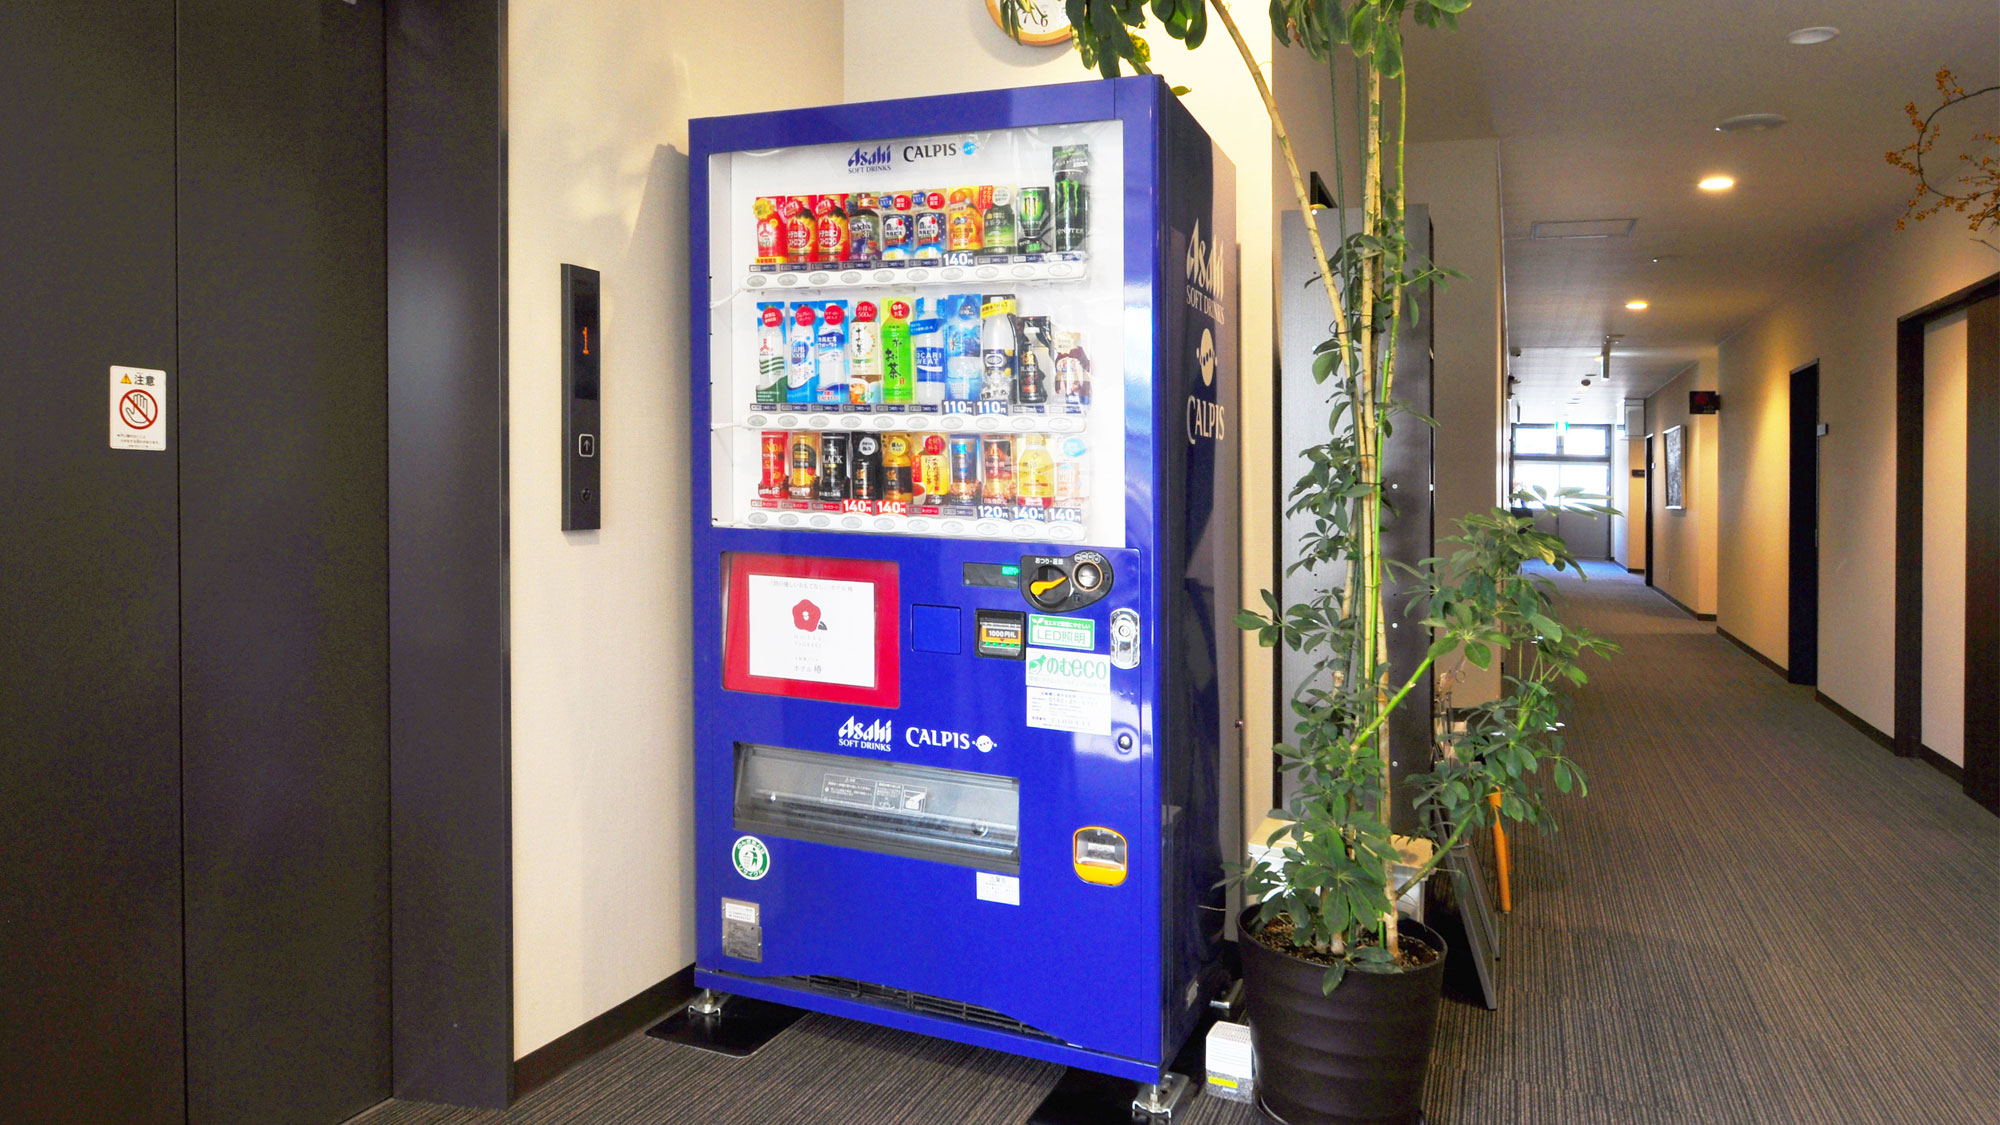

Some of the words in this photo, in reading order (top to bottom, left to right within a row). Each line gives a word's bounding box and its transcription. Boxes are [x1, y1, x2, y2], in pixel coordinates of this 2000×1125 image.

[848, 144, 891, 167] Asahi
[903, 143, 957, 162] CALPIS
[866, 165, 891, 173] DRINKS
[1186, 218, 1225, 301] Asahi
[583, 327, 589, 355] 1
[134, 374, 155, 386] 注意
[1186, 395, 1225, 445] CALPIS
[1037, 629, 1086, 645] LED照明
[1046, 656, 1107, 680] のむeco
[838, 715, 892, 743] Asahi
[906, 727, 970, 750] CALPIS
[838, 738, 860, 747] SOFT
[860, 741, 892, 752] DRINKS
